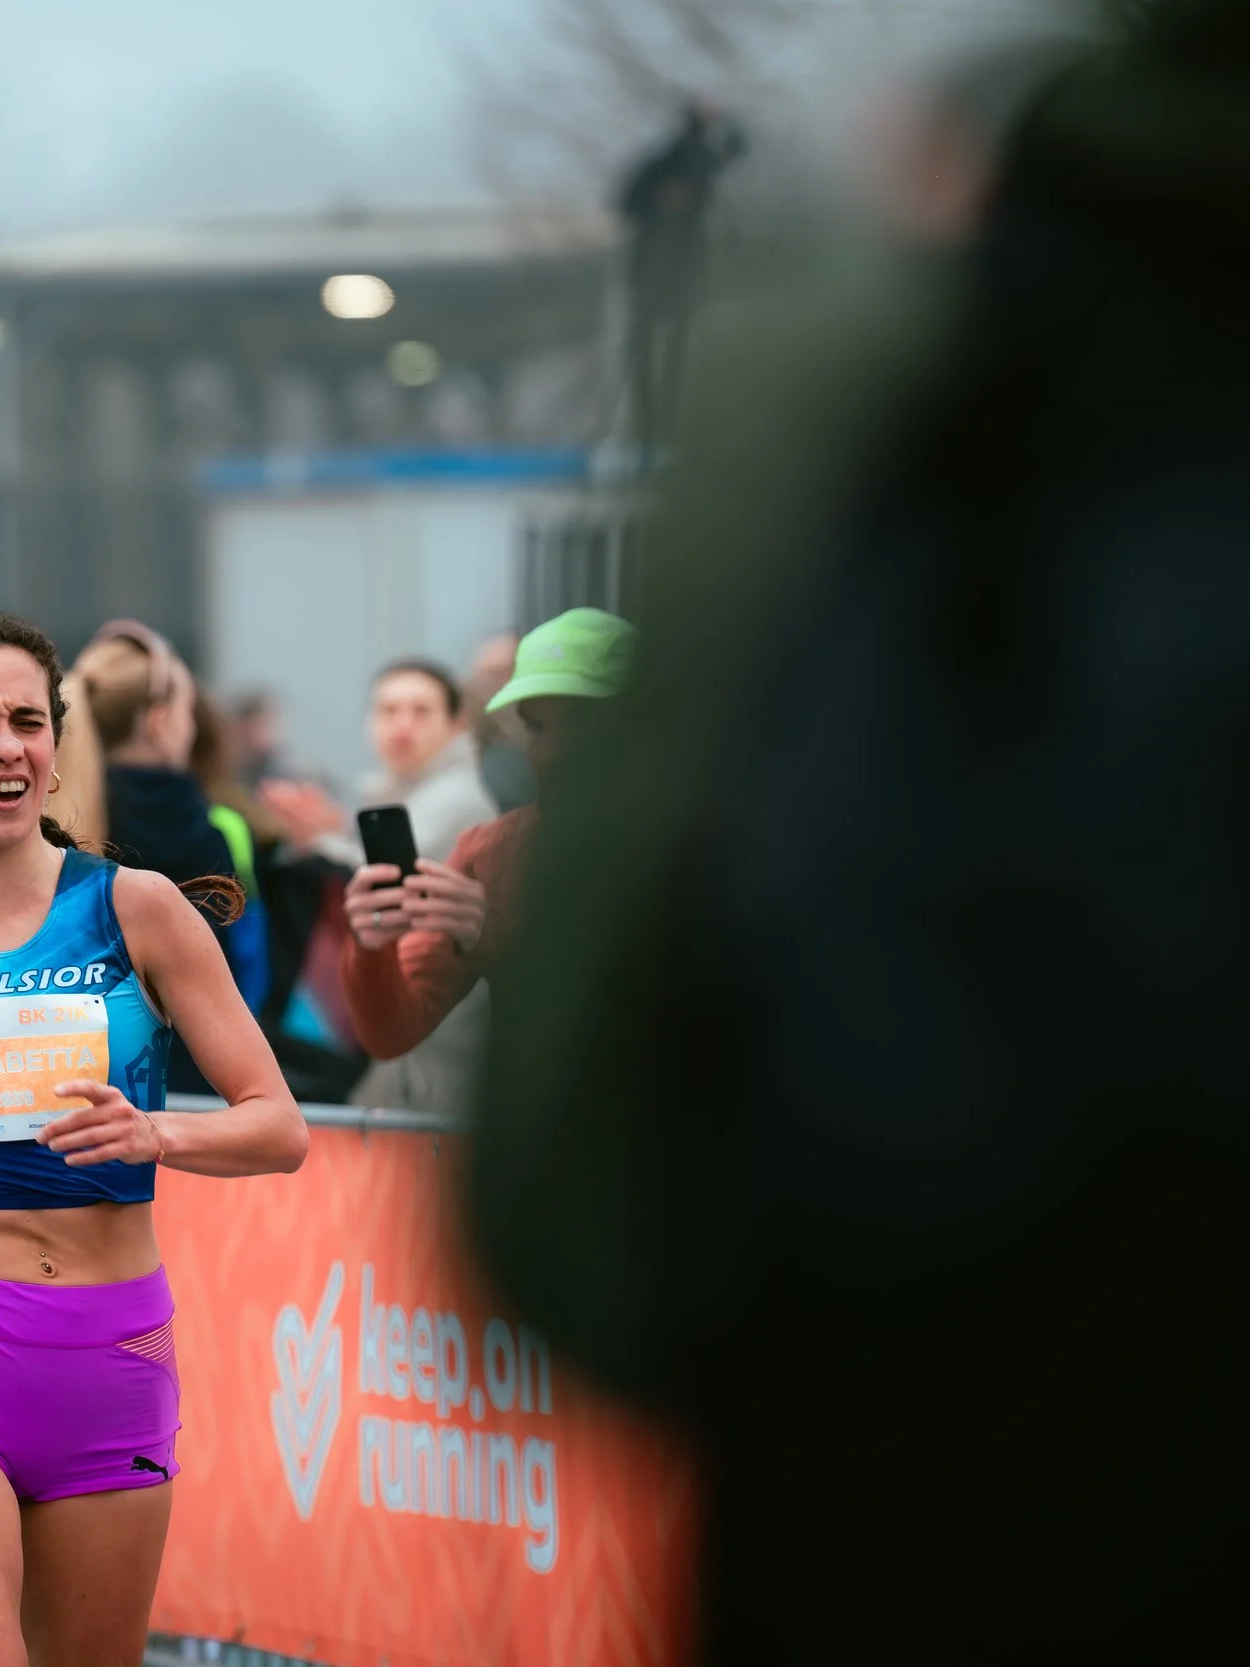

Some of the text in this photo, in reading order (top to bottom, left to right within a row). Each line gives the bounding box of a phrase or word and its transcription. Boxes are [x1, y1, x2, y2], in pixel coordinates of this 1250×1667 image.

[18, 1006, 89, 1025] BK 21K
[359, 1413, 560, 1575] running
